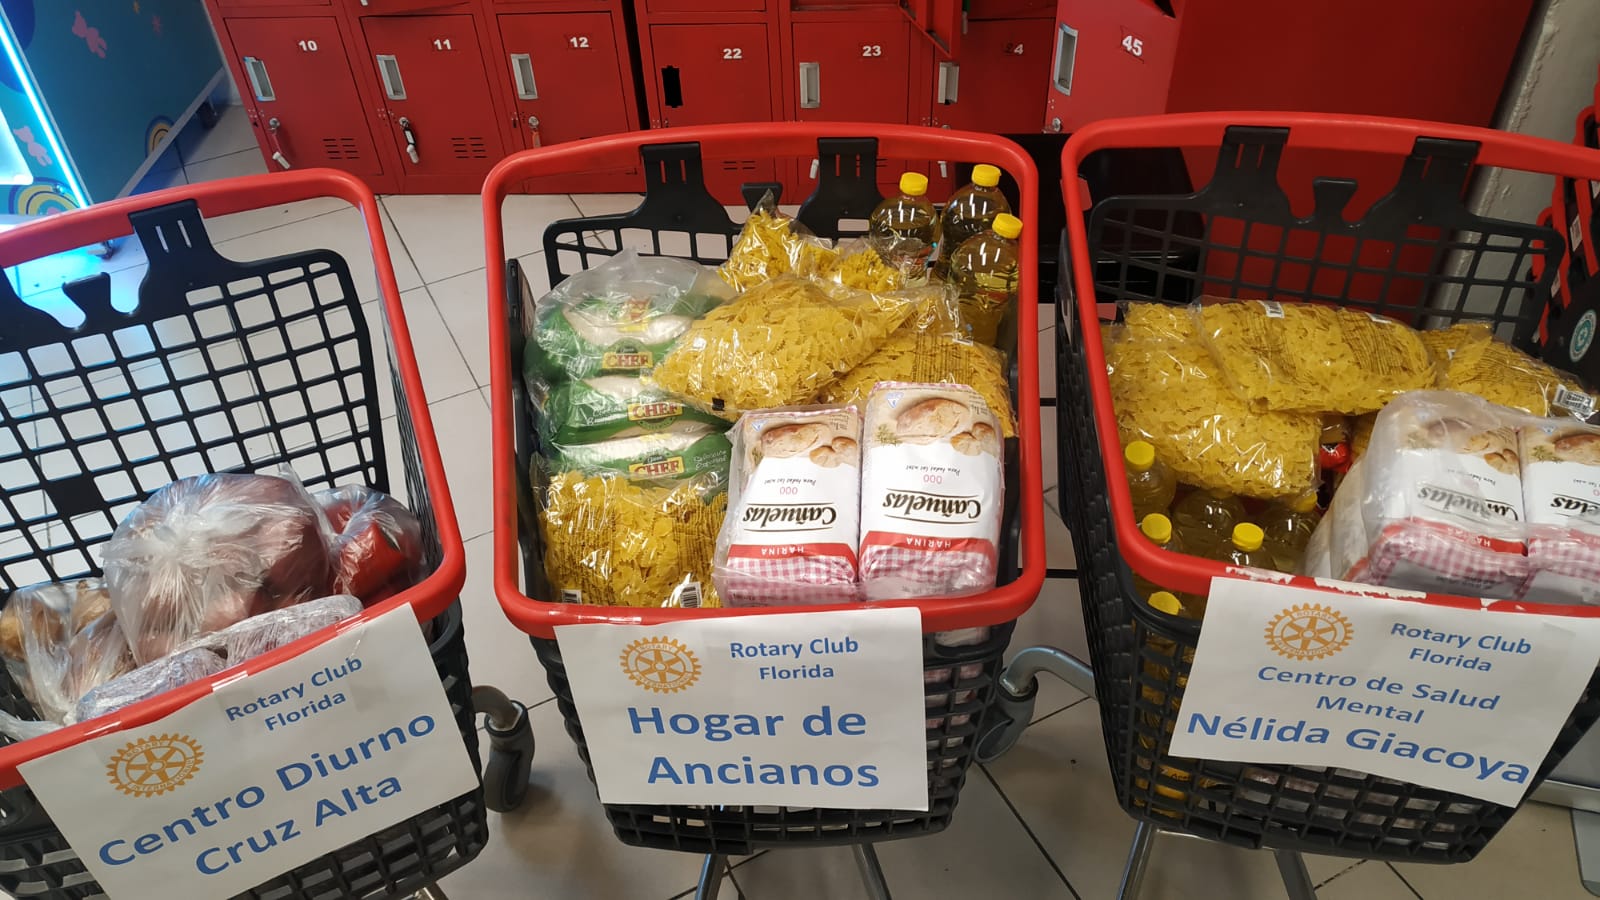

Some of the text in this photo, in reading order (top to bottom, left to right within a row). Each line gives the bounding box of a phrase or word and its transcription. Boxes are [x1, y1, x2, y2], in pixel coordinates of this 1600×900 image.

[299, 40, 318, 52] 10
[434, 39, 452, 51] 11
[570, 37, 590, 49] 12
[862, 45, 882, 57] 23
[1121, 35, 1143, 57] 45
[723, 48, 743, 60] 22
[606, 354, 649, 367] CHEF
[632, 403, 678, 418] CHEF
[634, 461, 679, 475] CHEF
[923, 474, 942, 484] 000
[779, 486, 798, 495] 000
[882, 492, 981, 519] Cañuelas
[743, 507, 836, 528] Cañuelas
[761, 546, 804, 556] HARINA
[906, 537, 951, 548] HARINA
[730, 637, 859, 659] Rotary Club
[1391, 623, 1532, 655] Rotary Club
[1409, 647, 1492, 672] Florida
[759, 664, 834, 680] Florida
[226, 656, 363, 721] Rotary Club
[1258, 666, 1500, 711] Centro de Salud
[264, 690, 347, 731] Florida
[1316, 695, 1424, 724] Mental
[628, 705, 867, 742] Hogar de
[1187, 712, 1531, 784] Nélida Giacoya
[647, 756, 880, 787] Ancianos
[99, 714, 436, 866] Centro Diurno
[195, 777, 402, 876] Cruz Alta
